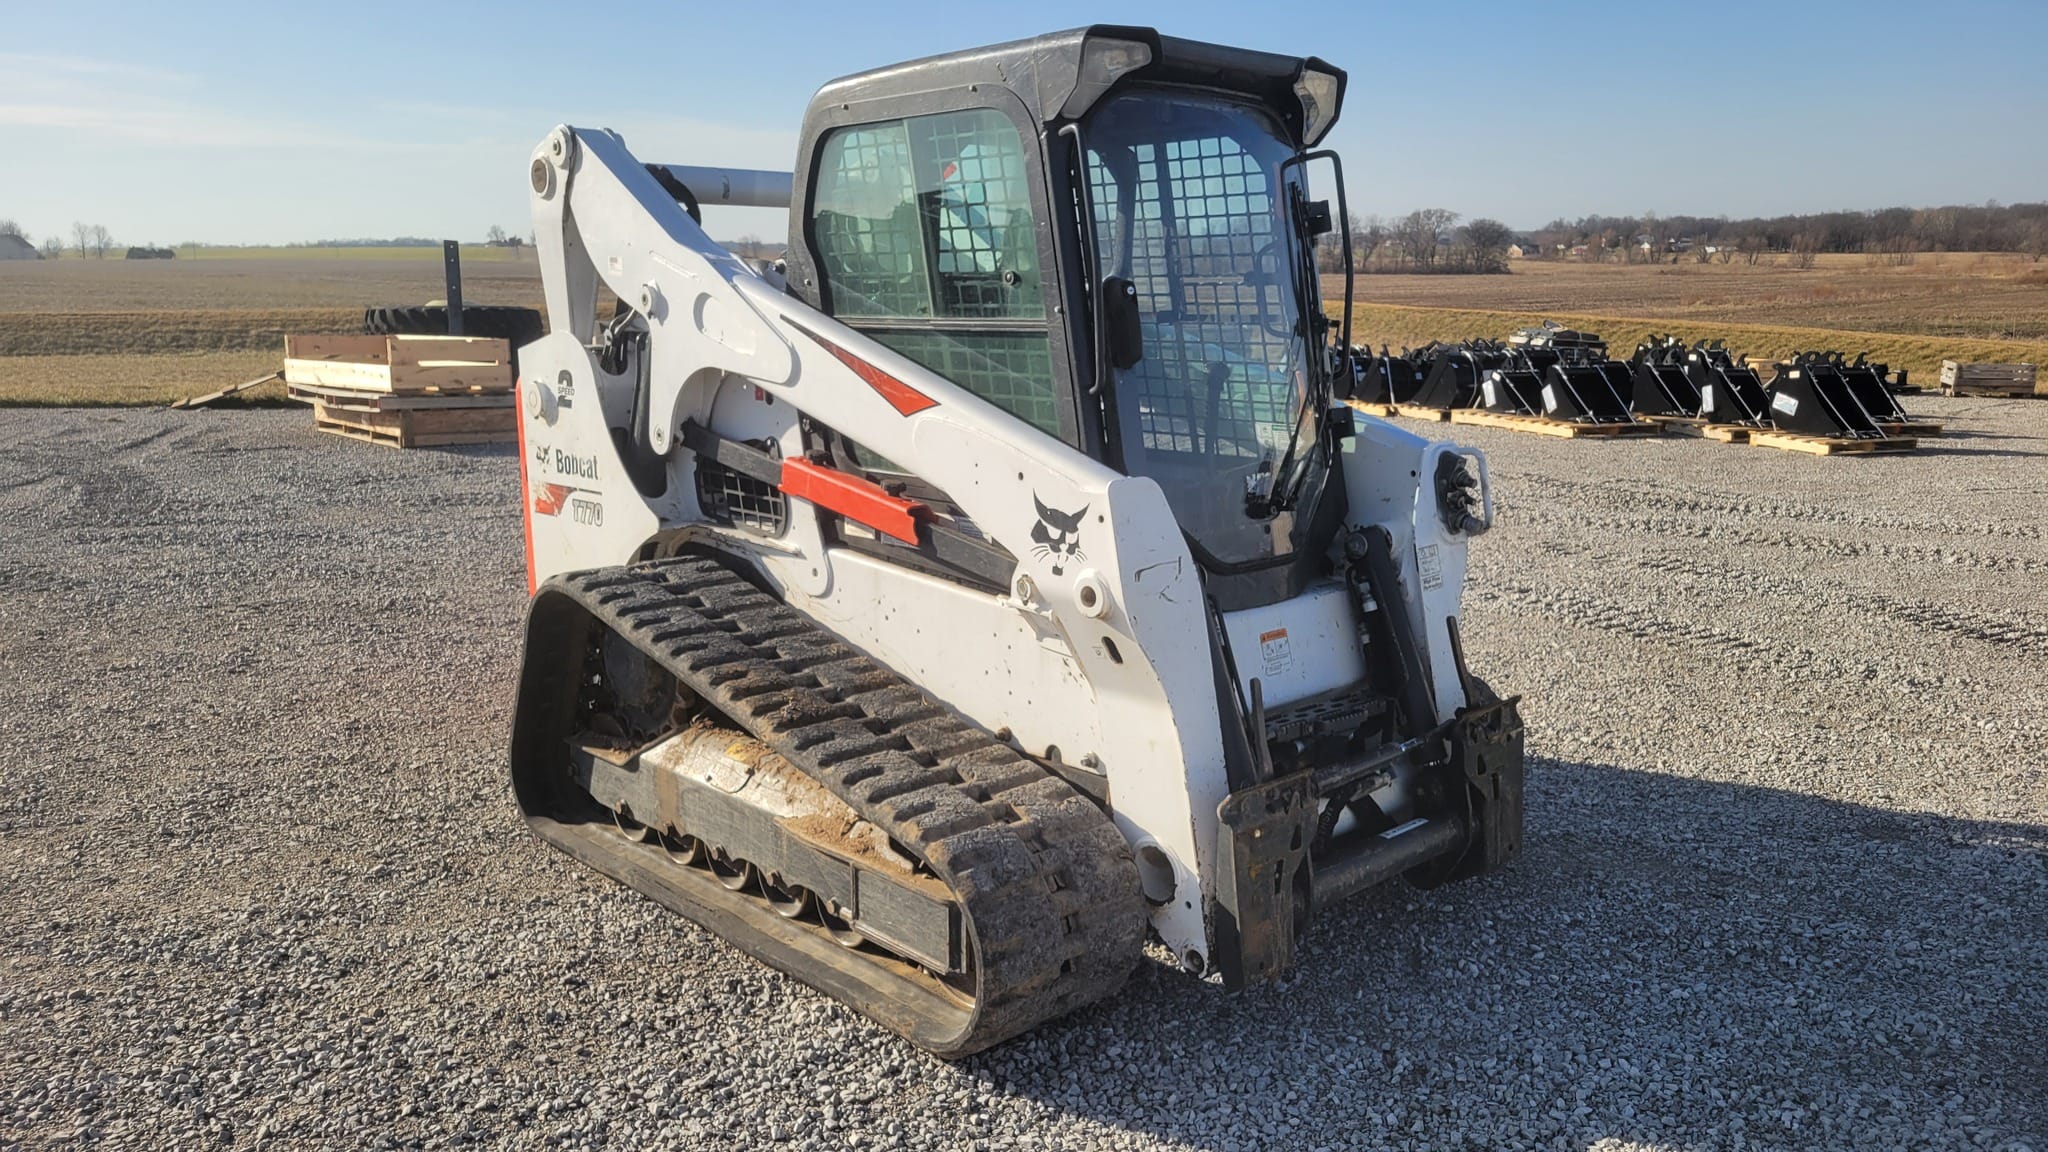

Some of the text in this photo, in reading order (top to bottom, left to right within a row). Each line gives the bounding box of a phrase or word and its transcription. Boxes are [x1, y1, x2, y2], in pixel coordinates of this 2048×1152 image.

[558, 386, 576, 396] SPEED
[555, 448, 599, 480] Bobcat
[572, 498, 603, 527] T770
